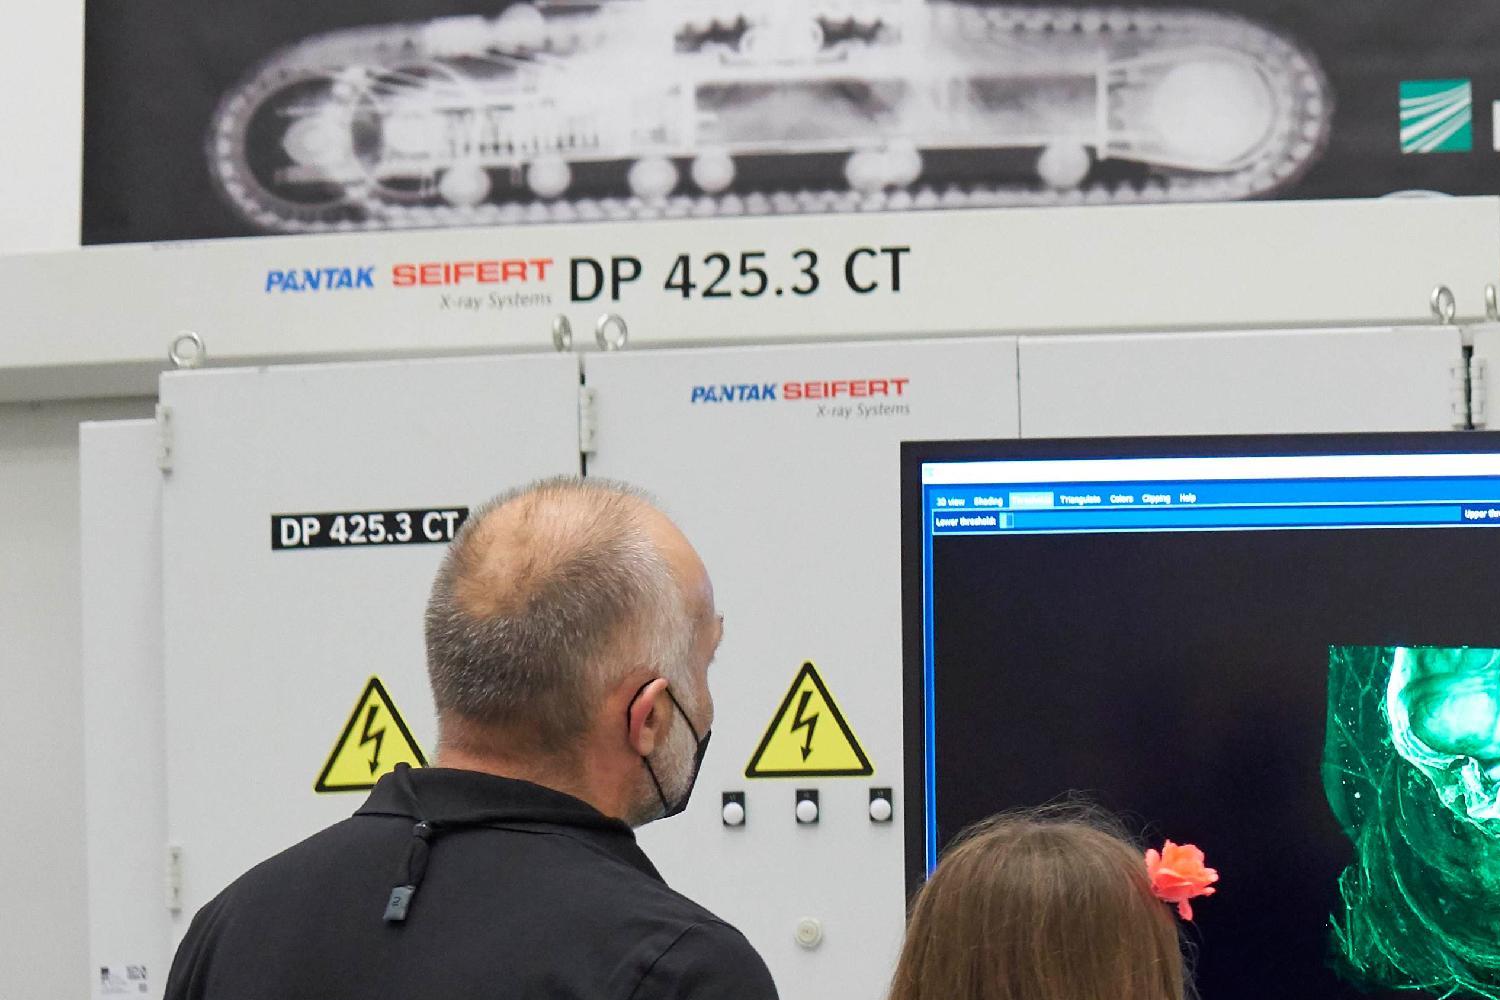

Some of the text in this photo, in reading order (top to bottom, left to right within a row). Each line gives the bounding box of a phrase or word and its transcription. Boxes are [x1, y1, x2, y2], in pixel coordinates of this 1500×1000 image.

[265, 257, 554, 294] PANTAK SEIFERT
[569, 245, 911, 303] DP 425.3 CT
[439, 291, 554, 312] X-ray Systems
[691, 379, 910, 403] PANTAK SEIFERT
[816, 400, 911, 419] X-ray Systems
[948, 497, 966, 507] view
[1109, 494, 1135, 504] Colors
[1179, 492, 1197, 504] Help
[935, 516, 959, 528] Lower
[1464, 509, 1488, 520] Upper
[280, 511, 459, 546] DP 425.3 CT
